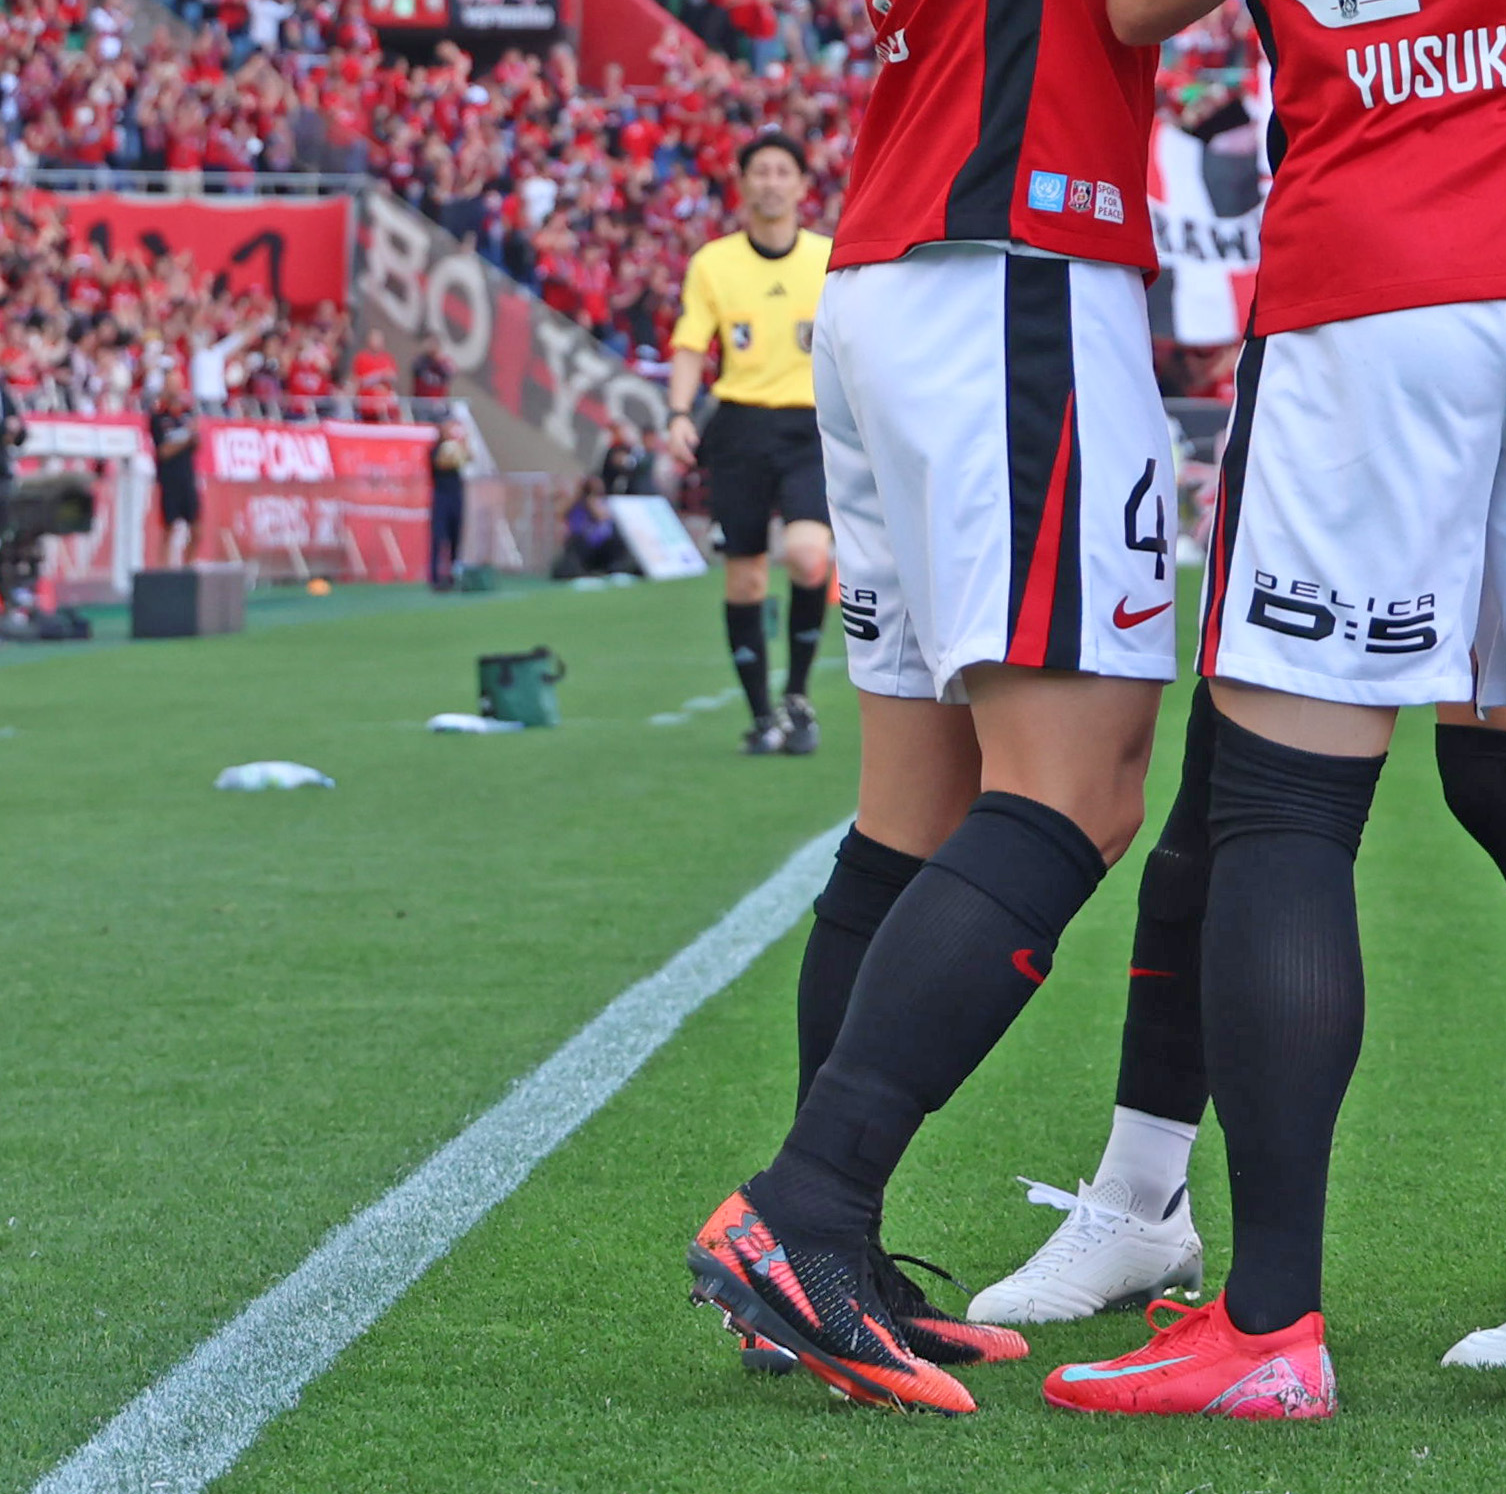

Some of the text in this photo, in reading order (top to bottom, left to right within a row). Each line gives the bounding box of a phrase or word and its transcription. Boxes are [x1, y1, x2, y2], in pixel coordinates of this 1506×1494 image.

[1123, 458, 1168, 581] 4
[1246, 587, 1438, 654] D:5
[1255, 569, 1435, 617] DELICA
